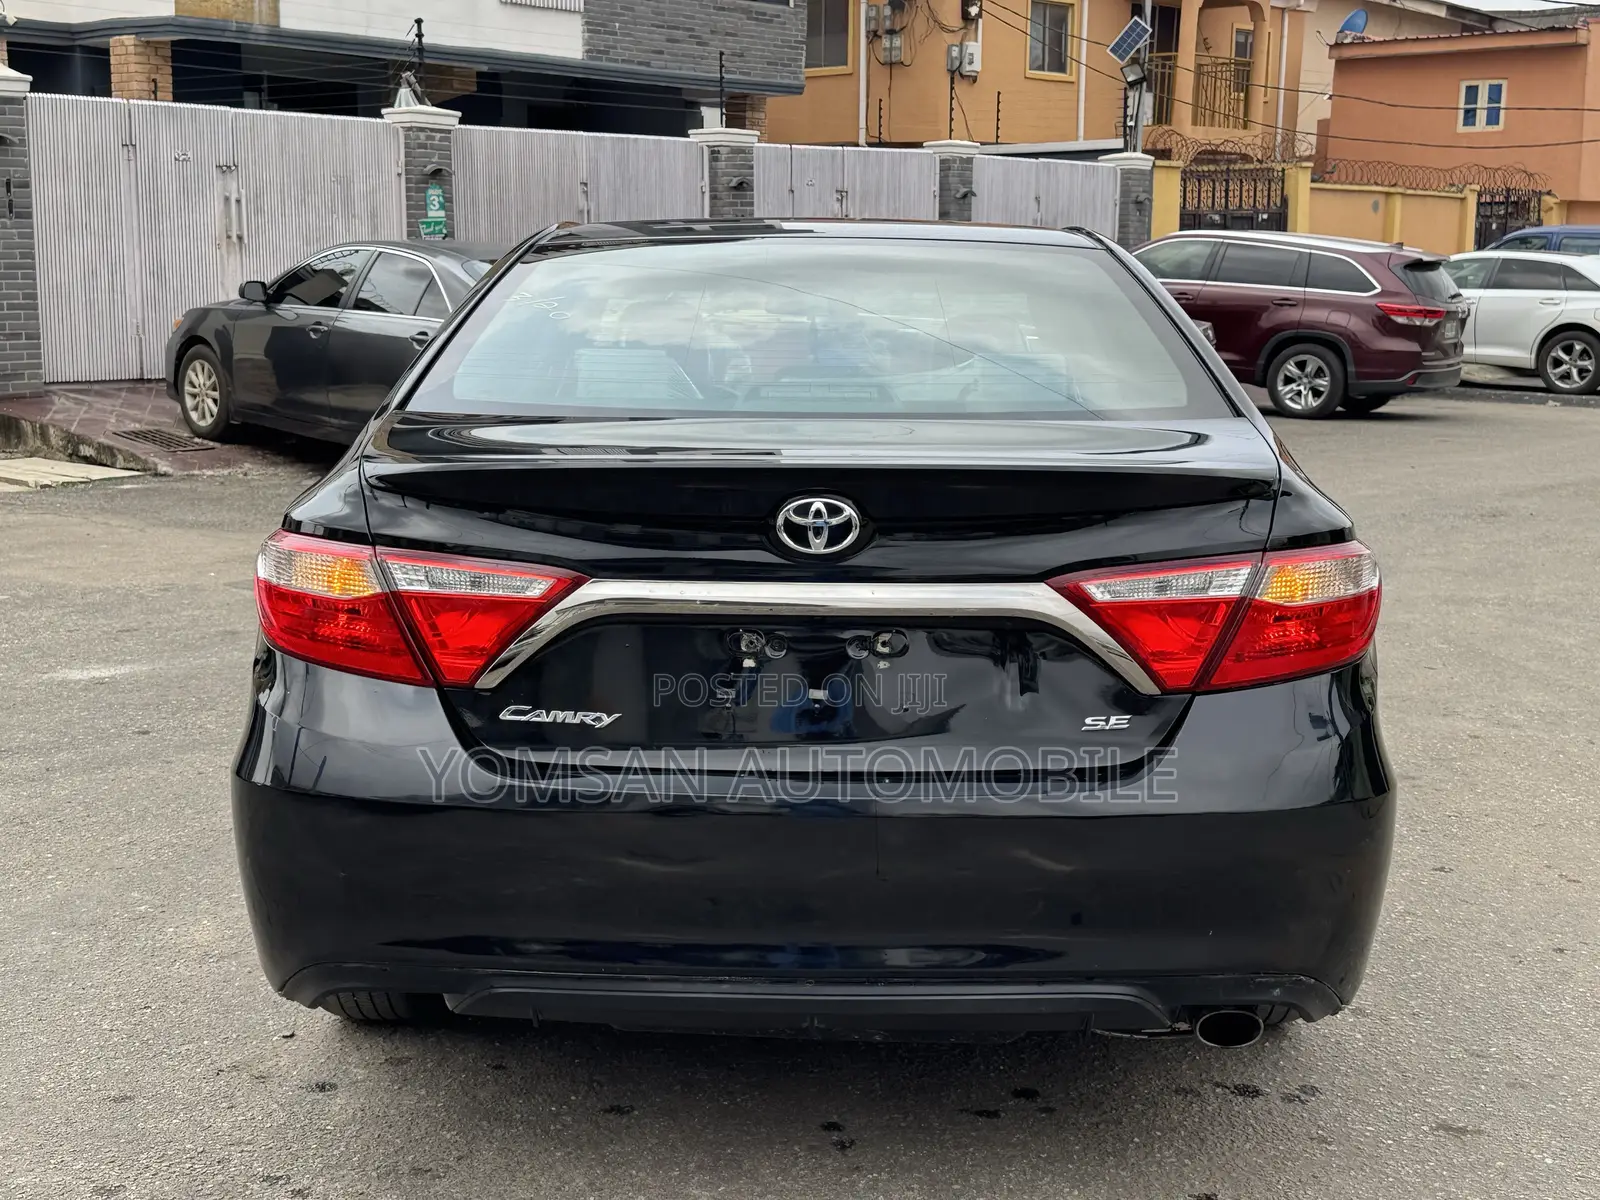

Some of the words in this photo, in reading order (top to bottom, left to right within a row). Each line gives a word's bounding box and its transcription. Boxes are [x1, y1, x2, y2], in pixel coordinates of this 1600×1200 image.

[429, 195, 441, 211] 3
[499, 705, 623, 728] CAMRY
[1081, 714, 1133, 731] SE
